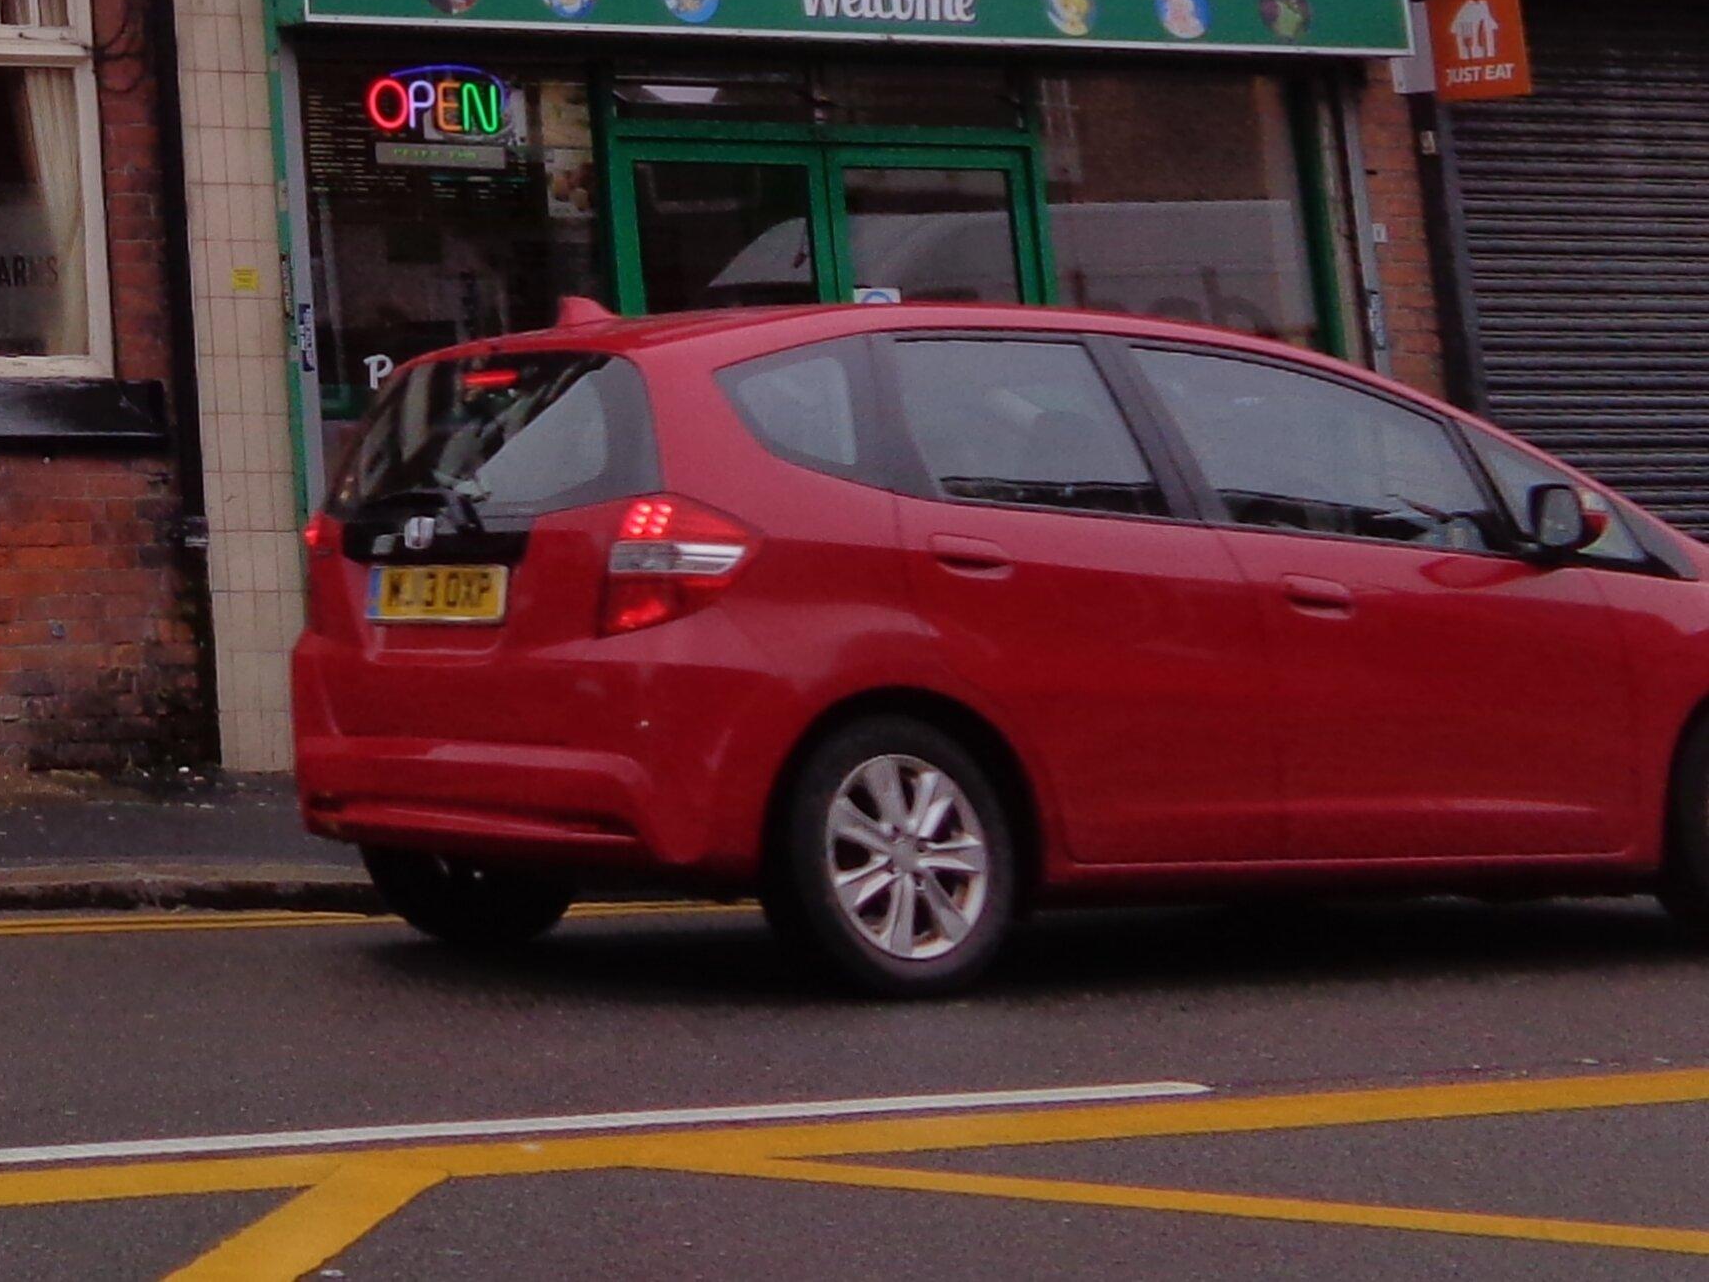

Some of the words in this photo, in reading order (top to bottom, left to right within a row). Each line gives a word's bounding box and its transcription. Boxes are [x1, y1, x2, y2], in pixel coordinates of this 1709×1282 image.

[1446, 66, 1481, 86] JUST
[1484, 62, 1515, 81] EAT
[367, 77, 500, 133] OPEN
